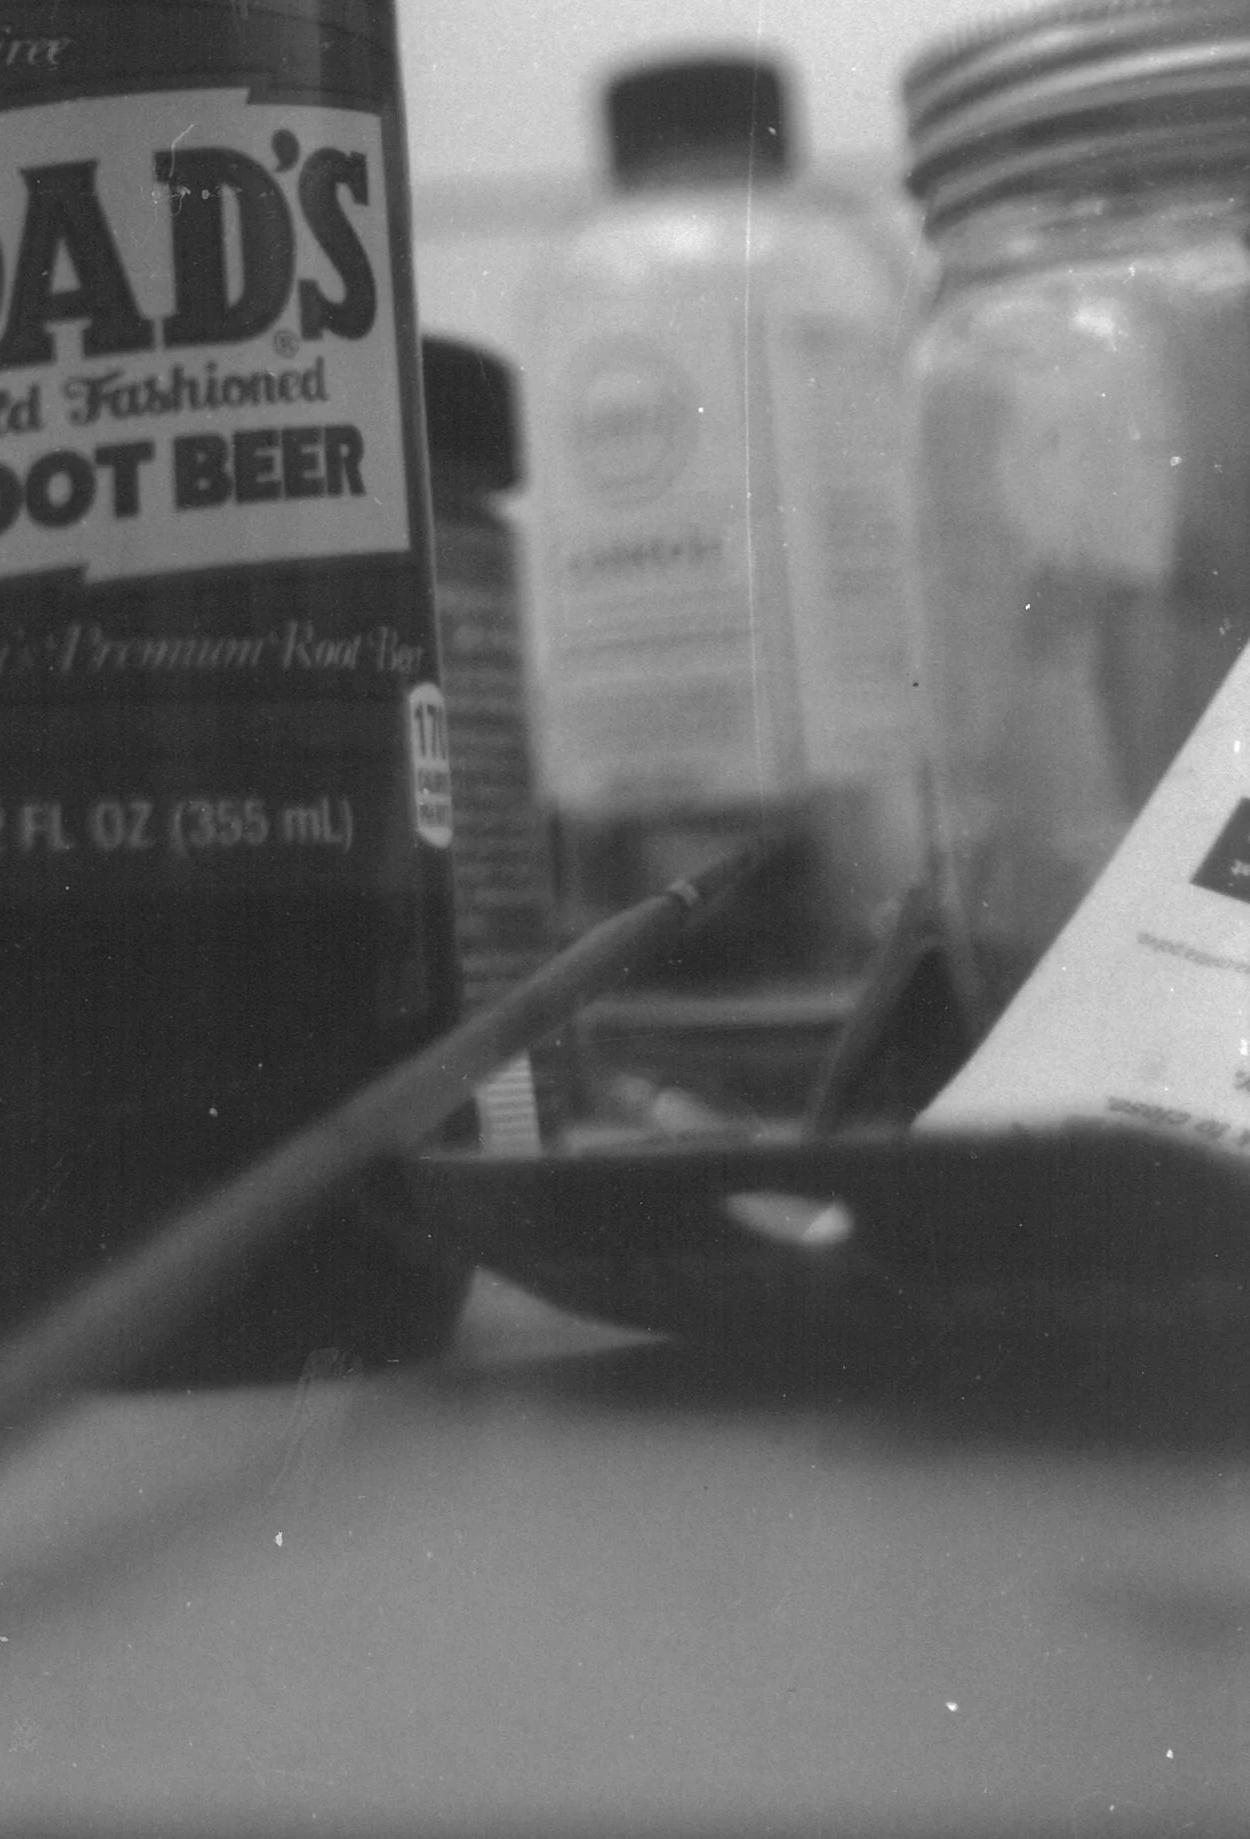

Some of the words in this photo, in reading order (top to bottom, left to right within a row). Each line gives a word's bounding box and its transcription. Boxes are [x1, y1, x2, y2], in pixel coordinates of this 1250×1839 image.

[60, 355, 330, 427] Fashioned
[172, 423, 367, 512] BEER
[18, 798, 77, 852] FL
[88, 798, 157, 850] OZ
[168, 795, 271, 859] (355
[279, 794, 355, 856] mL)
